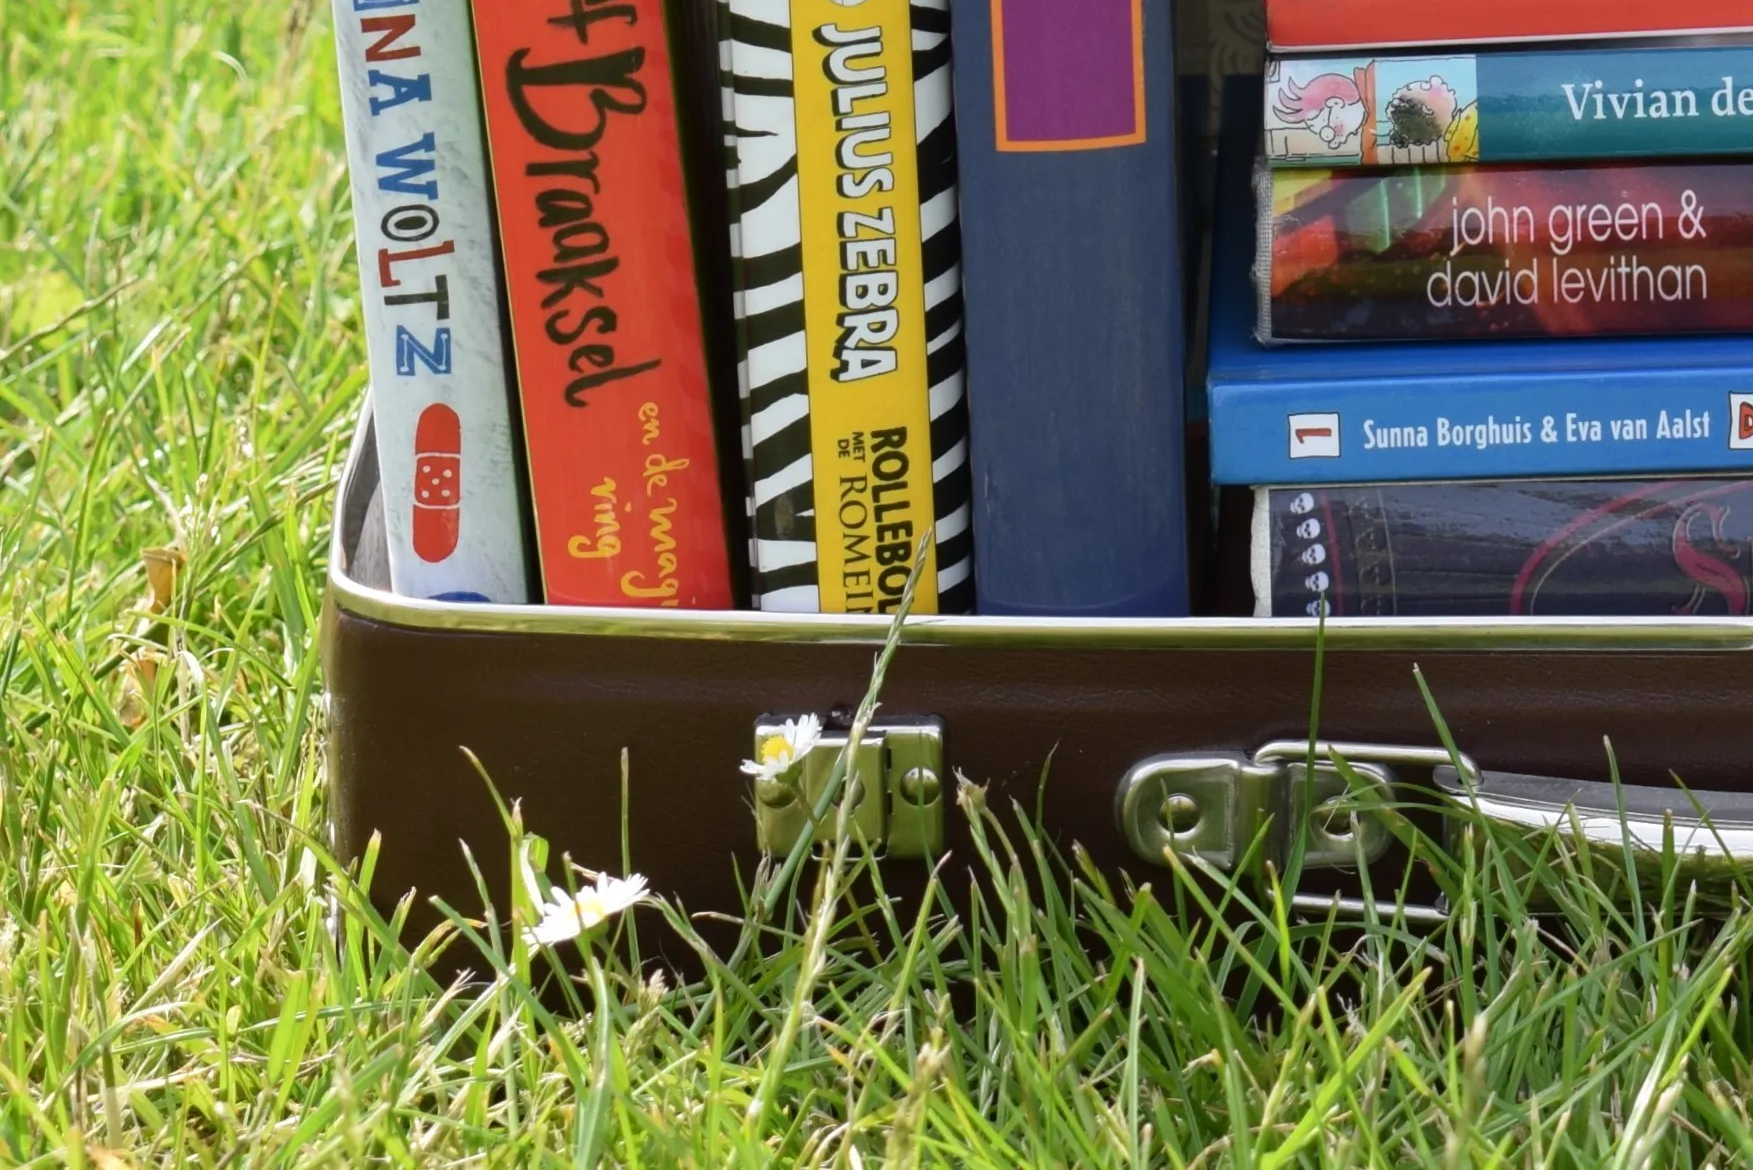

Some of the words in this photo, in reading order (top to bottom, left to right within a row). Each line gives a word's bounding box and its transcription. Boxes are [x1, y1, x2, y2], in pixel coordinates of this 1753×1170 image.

[812, 23, 895, 199] JULIUS
[1561, 79, 1698, 121] Vivian
[505, 46, 662, 409] Braaksel
[1449, 196, 1535, 255] john
[1549, 200, 1663, 253] green
[1677, 188, 1706, 239] &
[375, 132, 455, 376] WOLTZ
[830, 206, 899, 383] ZEBRA
[1426, 257, 1539, 309] david
[1553, 256, 1707, 306] levithan
[638, 402, 660, 445] en
[837, 439, 850, 458] DE
[852, 431, 866, 462] MET
[1363, 419, 1428, 450] Sunna
[1437, 416, 1531, 450] Borghuis
[1540, 416, 1559, 443] &
[1566, 412, 1601, 442] Eva
[1610, 417, 1647, 441] van
[1656, 410, 1710, 439] Aalst
[642, 454, 690, 496] de
[568, 476, 631, 559] ring
